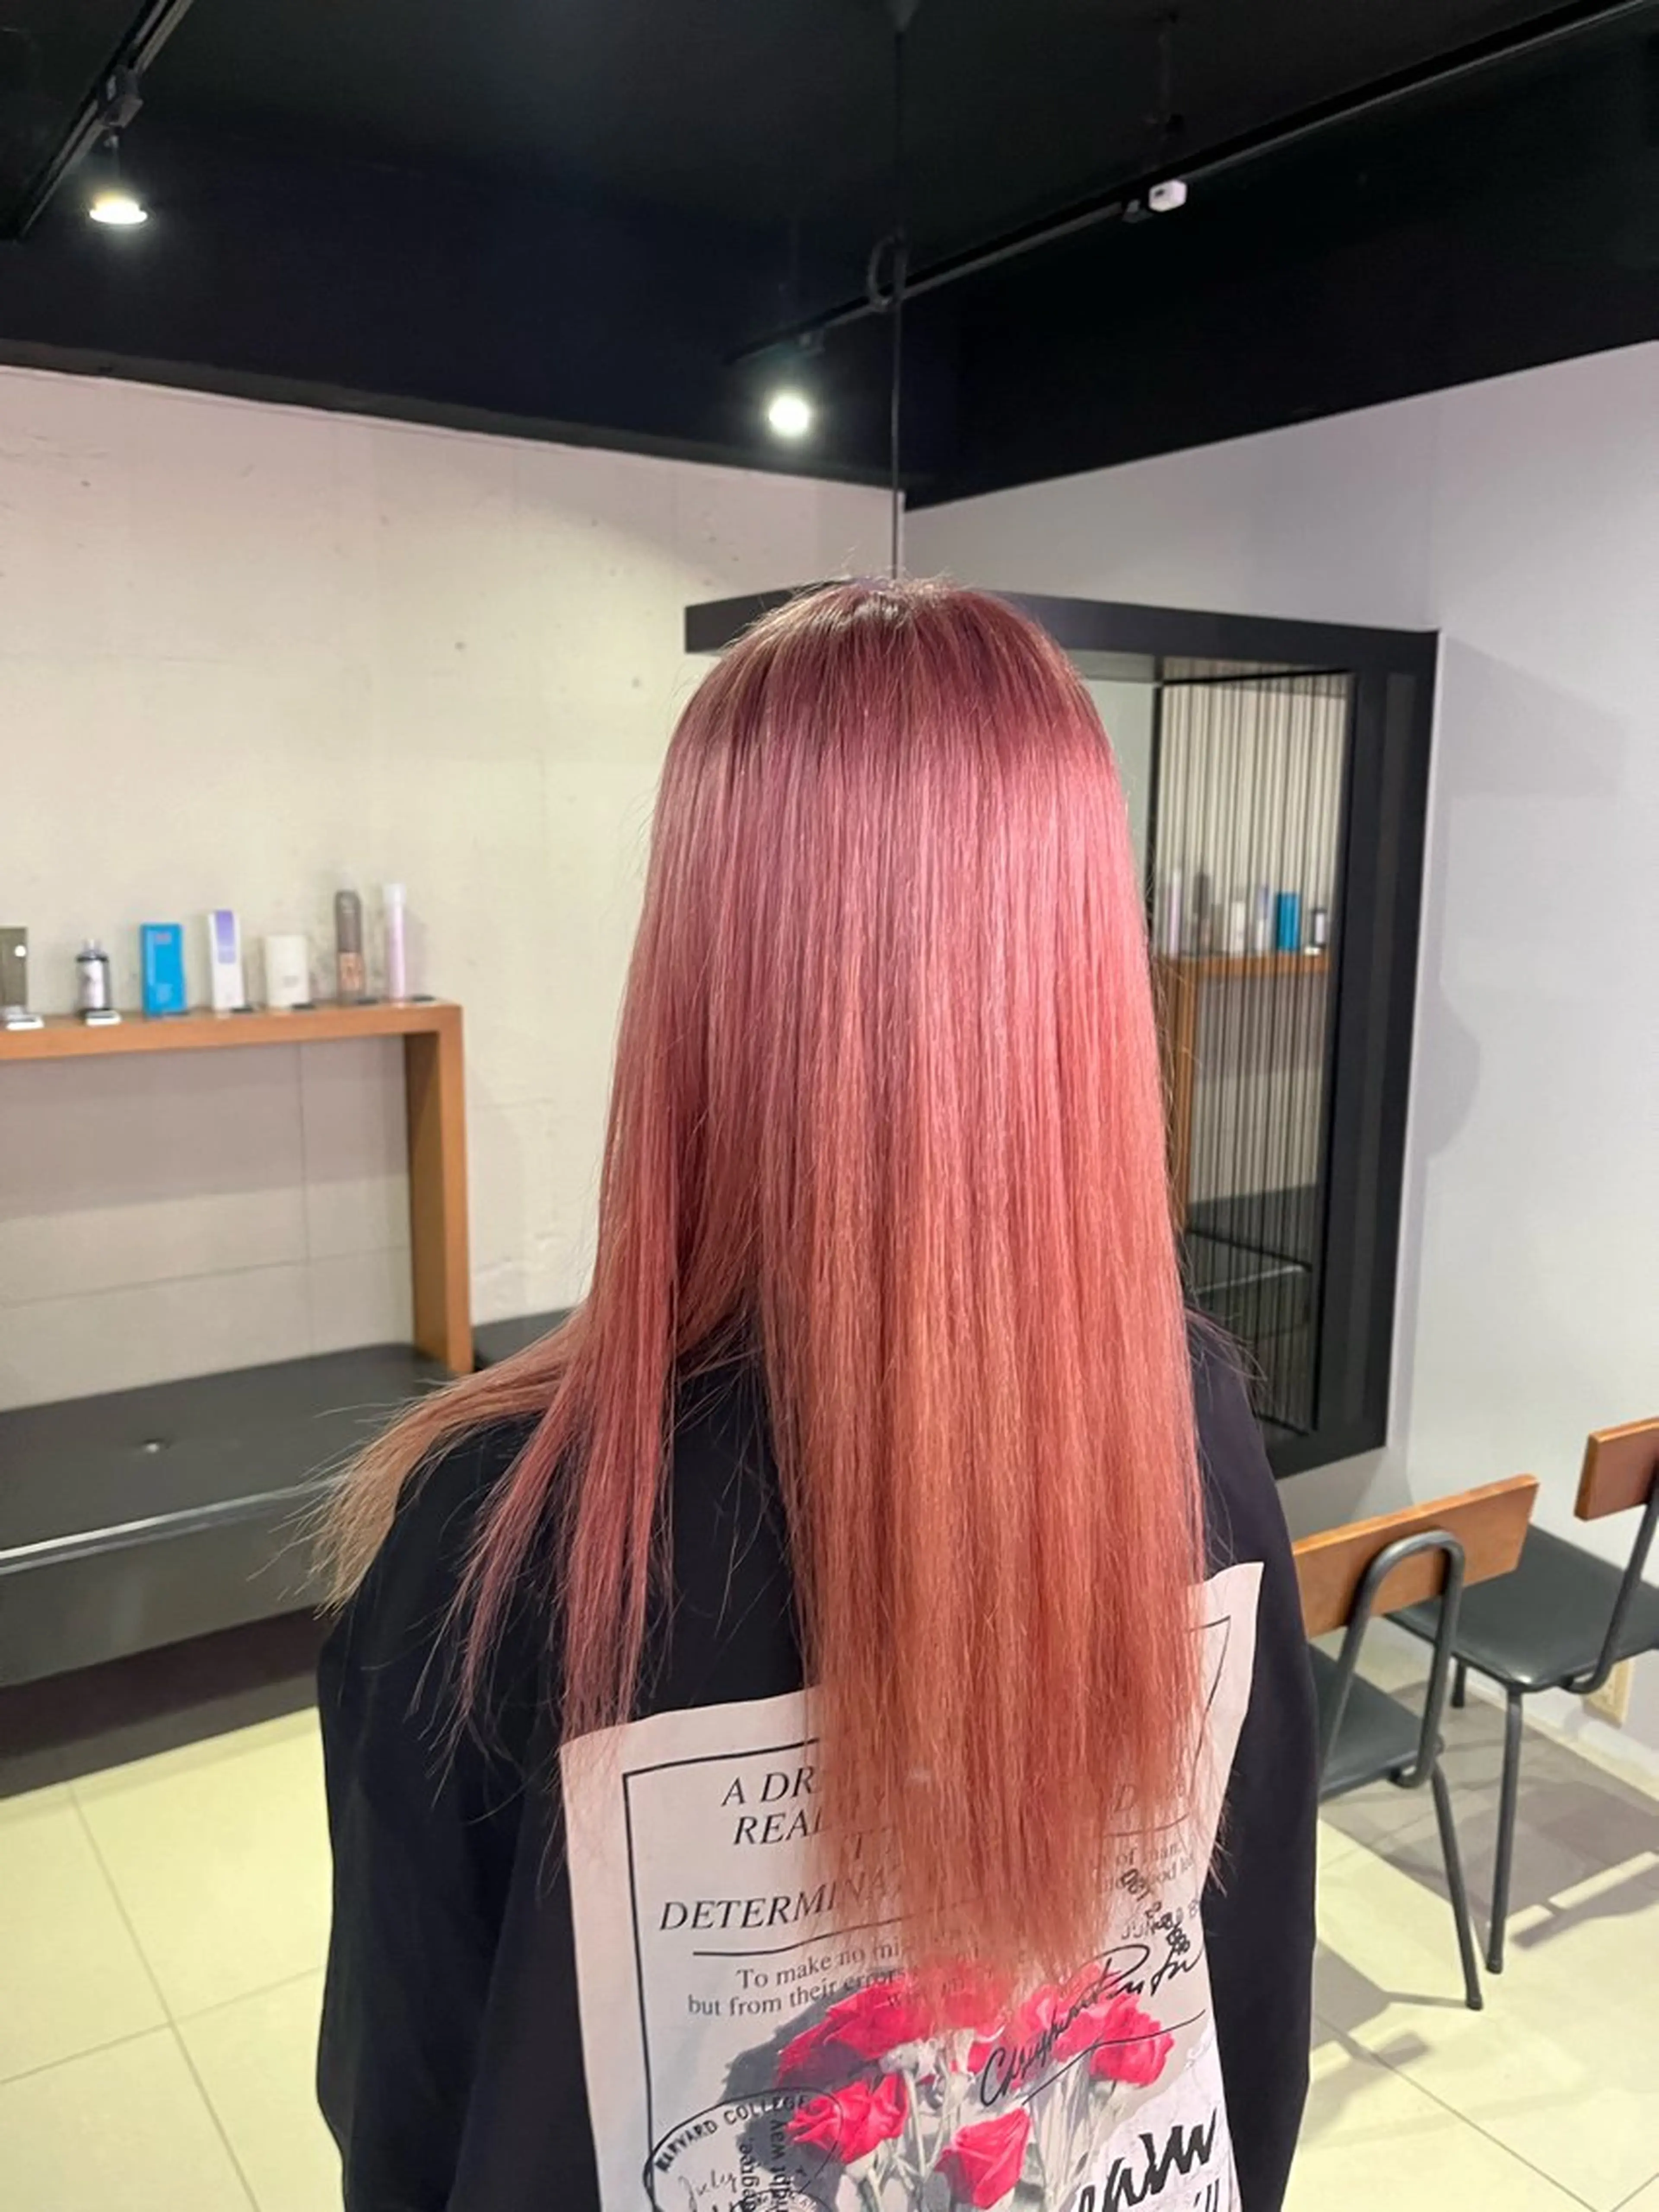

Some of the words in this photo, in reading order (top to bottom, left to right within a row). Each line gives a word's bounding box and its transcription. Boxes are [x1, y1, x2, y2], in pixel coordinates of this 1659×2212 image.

[721, 1777, 746, 1807] A
[736, 1969, 768, 1990] To
[776, 1954, 832, 1987] make
[838, 1947, 865, 1967] no
[688, 1995, 721, 2016] but
[729, 1996, 782, 2017] from
[789, 1976, 838, 2009] their
